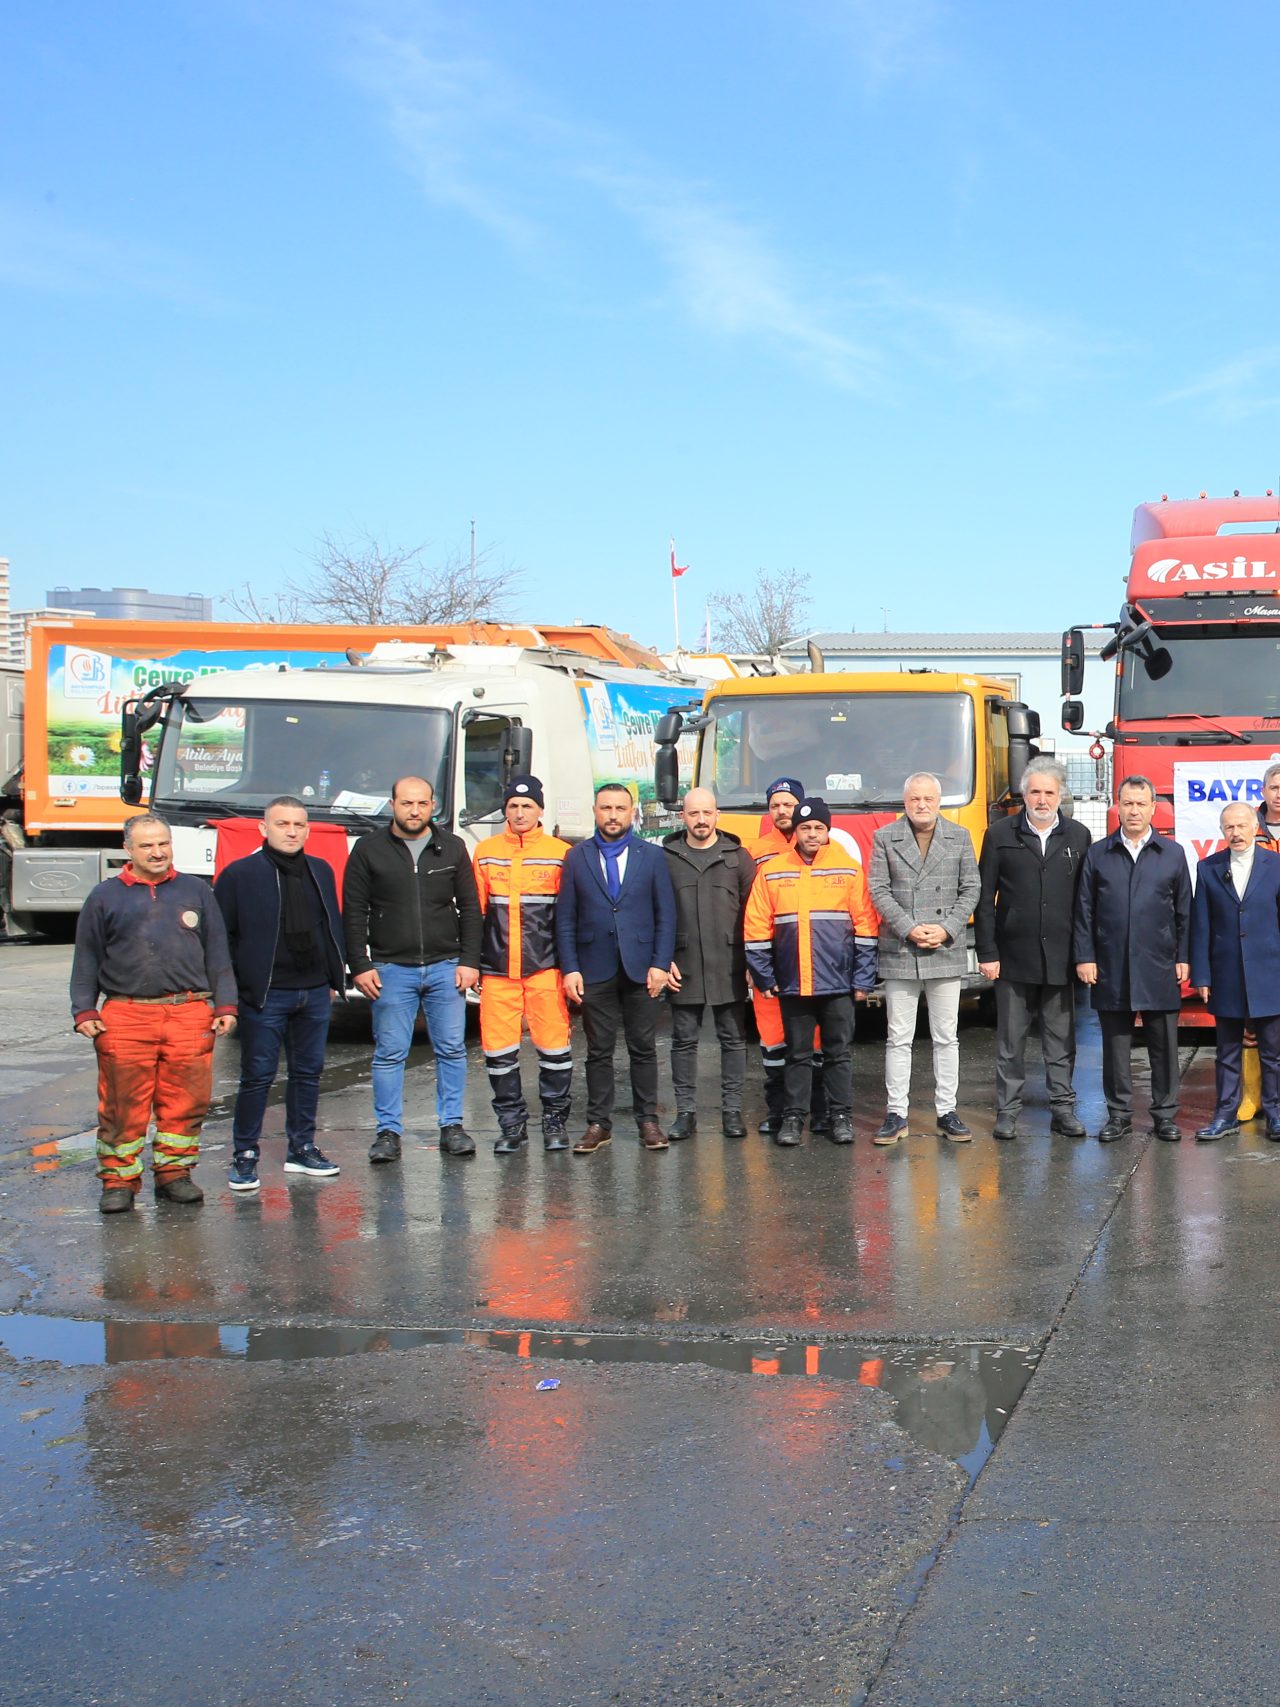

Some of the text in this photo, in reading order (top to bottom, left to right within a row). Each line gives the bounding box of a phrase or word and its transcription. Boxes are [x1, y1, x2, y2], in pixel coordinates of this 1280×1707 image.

[1171, 557, 1276, 581] ASİL
[133, 666, 194, 692] Çevre
[621, 710, 651, 740] Çevre
